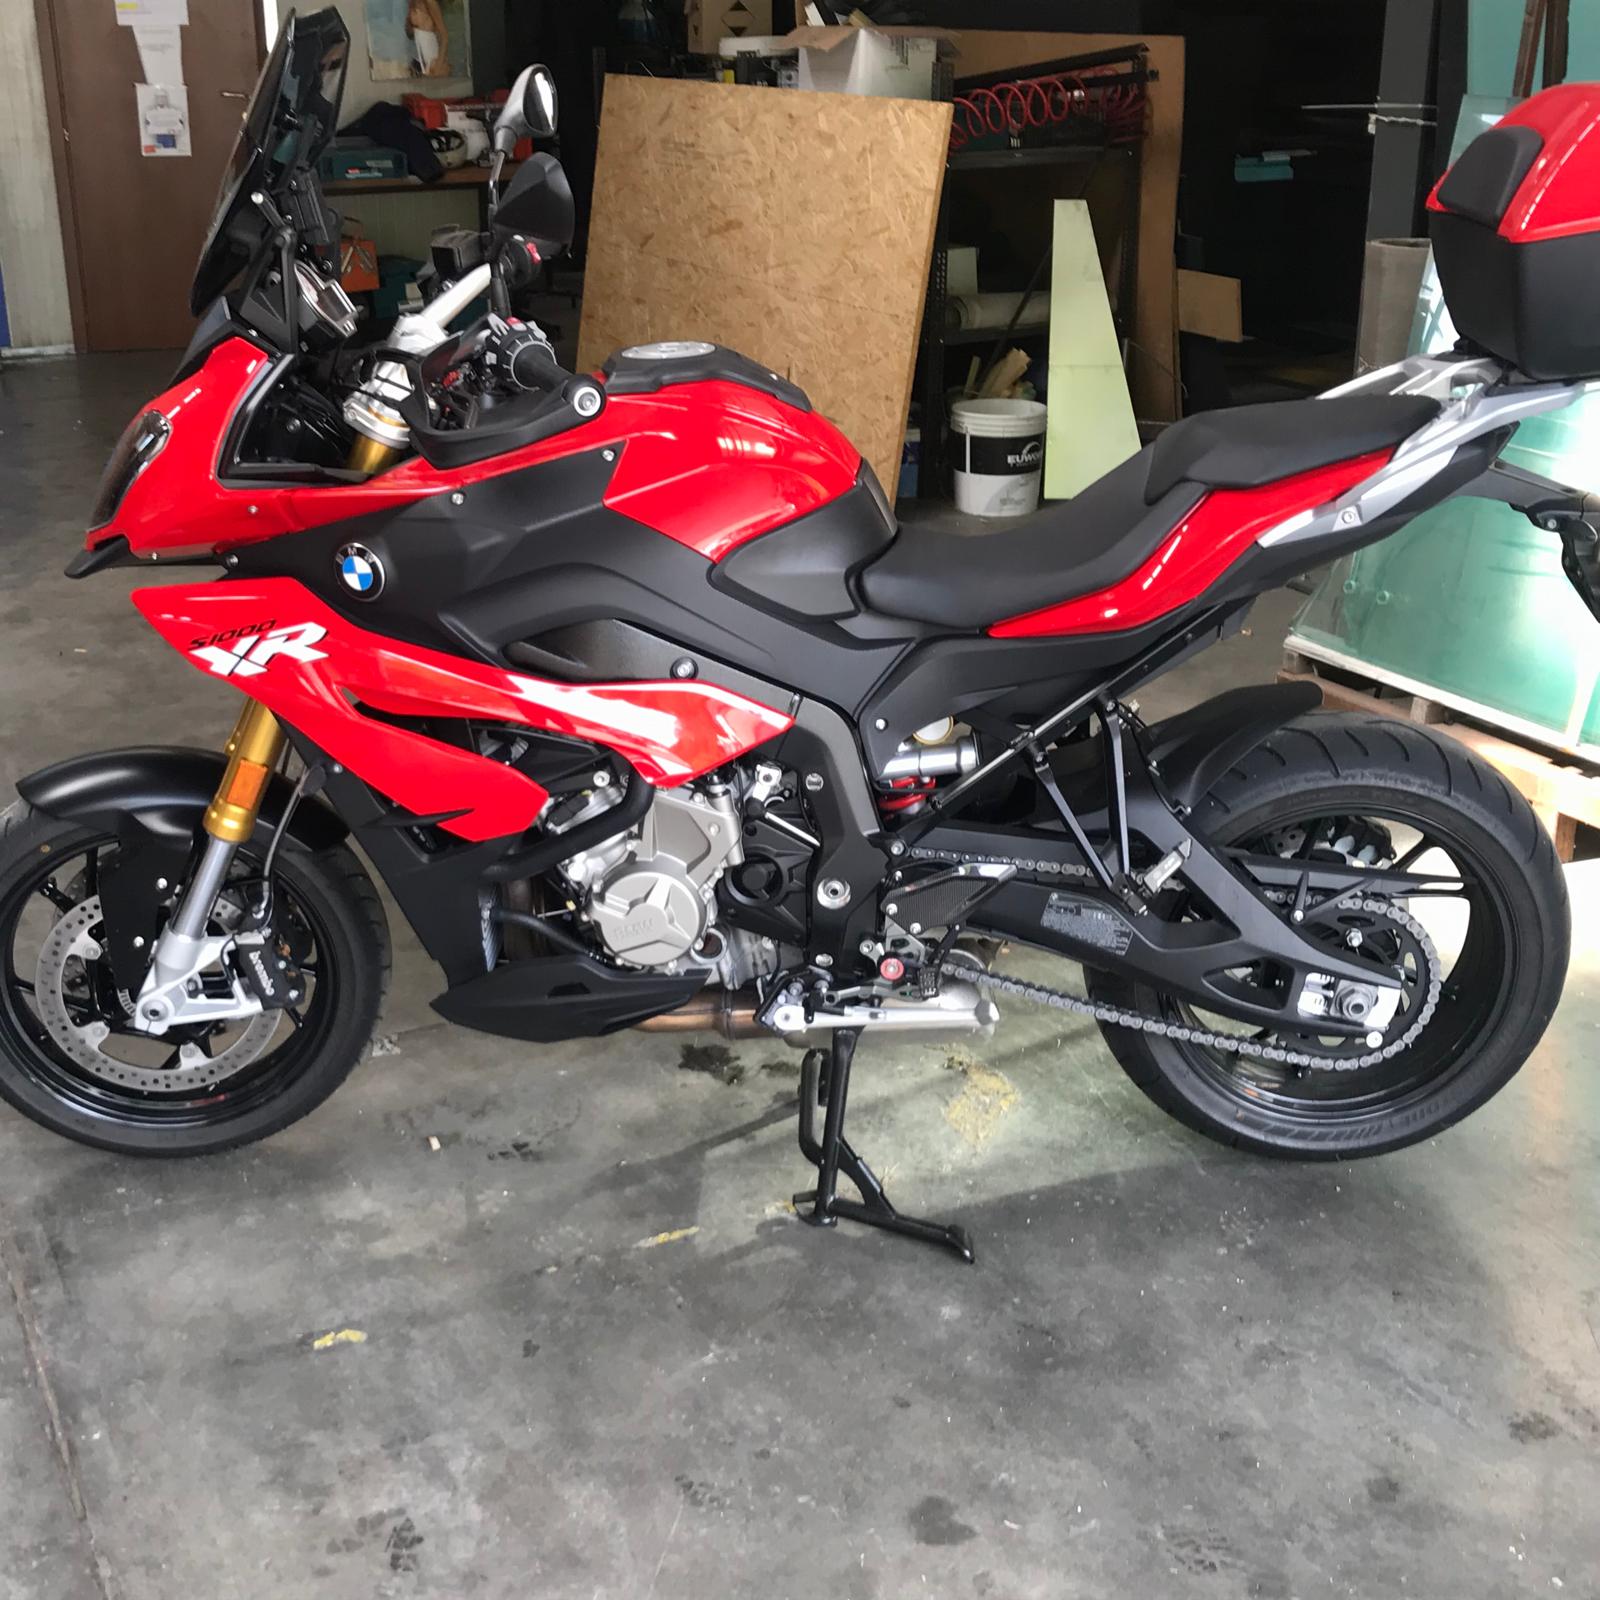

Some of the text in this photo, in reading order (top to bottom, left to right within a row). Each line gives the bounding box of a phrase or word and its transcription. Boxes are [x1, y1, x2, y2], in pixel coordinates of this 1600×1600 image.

[189, 619, 276, 650] S1000
[190, 622, 329, 677] XR
[249, 950, 275, 995] brembo
